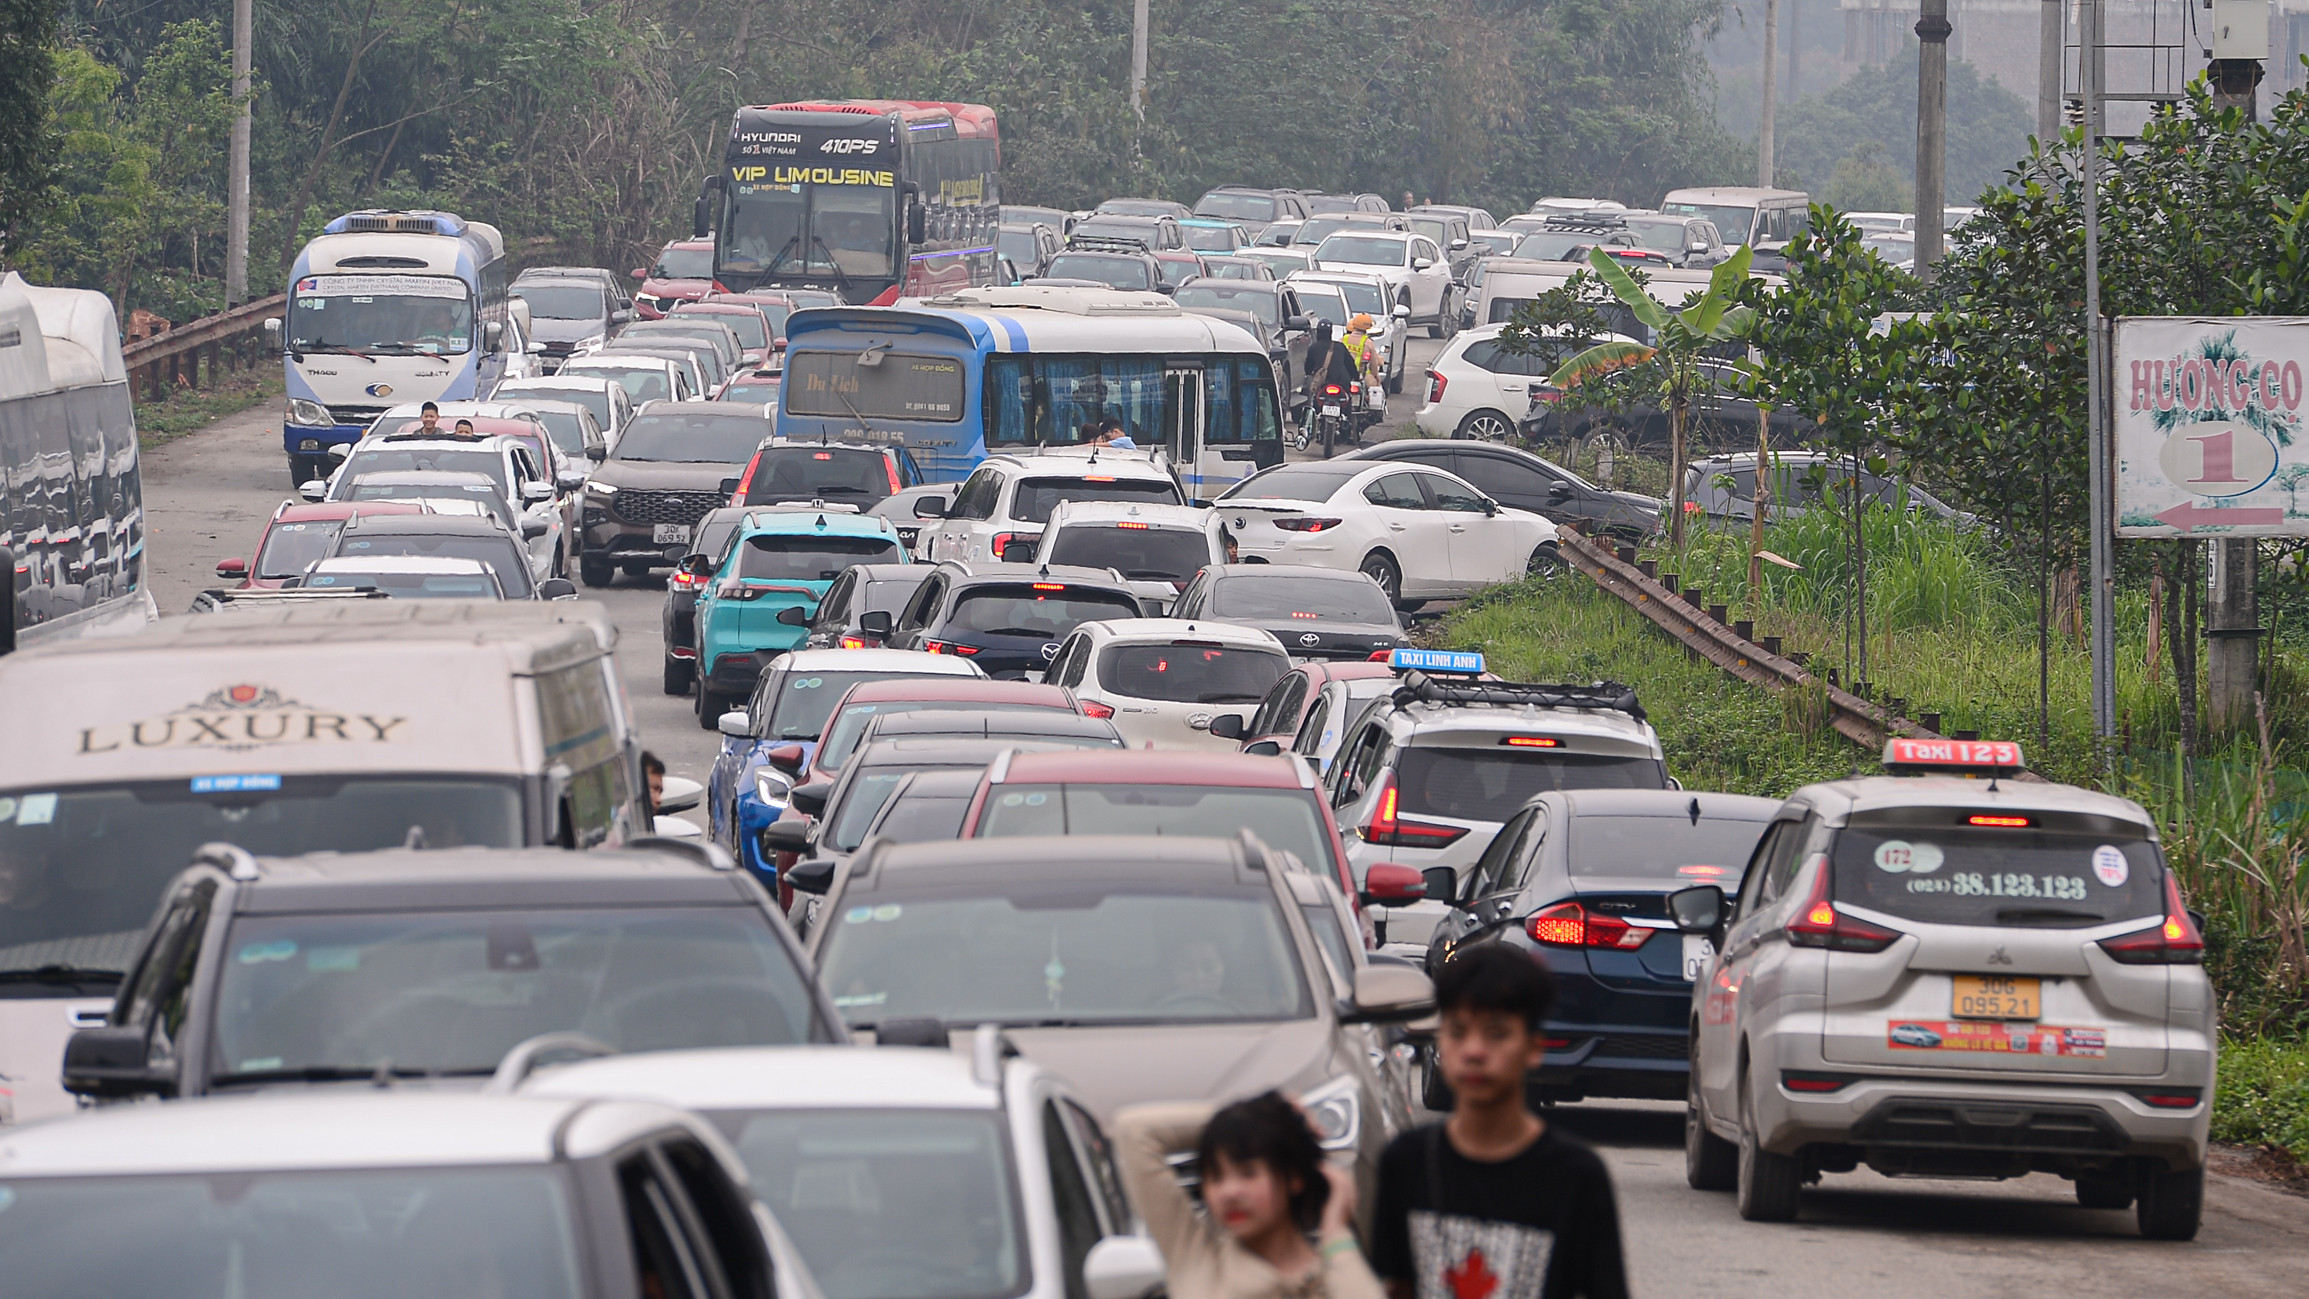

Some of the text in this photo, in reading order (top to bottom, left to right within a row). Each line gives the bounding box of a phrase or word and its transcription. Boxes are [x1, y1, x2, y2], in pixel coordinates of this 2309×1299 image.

[741, 132, 801, 143] HYUNDAI
[820, 139, 880, 155] 410PS
[742, 145, 752, 154] SỐ
[777, 147, 796, 155] NAM
[732, 166, 894, 187] VIP LIMOUSINE
[2130, 354, 2303, 424] HƯƠNG CỌ
[2186, 430, 2249, 483] 1
[1400, 652, 1476, 668] TAXI LINH ANH
[77, 713, 407, 755] LUXURY
[1900, 743, 1953, 760] Taxi
[1906, 871, 2087, 900] (024) 38.123.123
[1979, 976, 2016, 995] 30G
[1961, 996, 2029, 1016] 095.21
